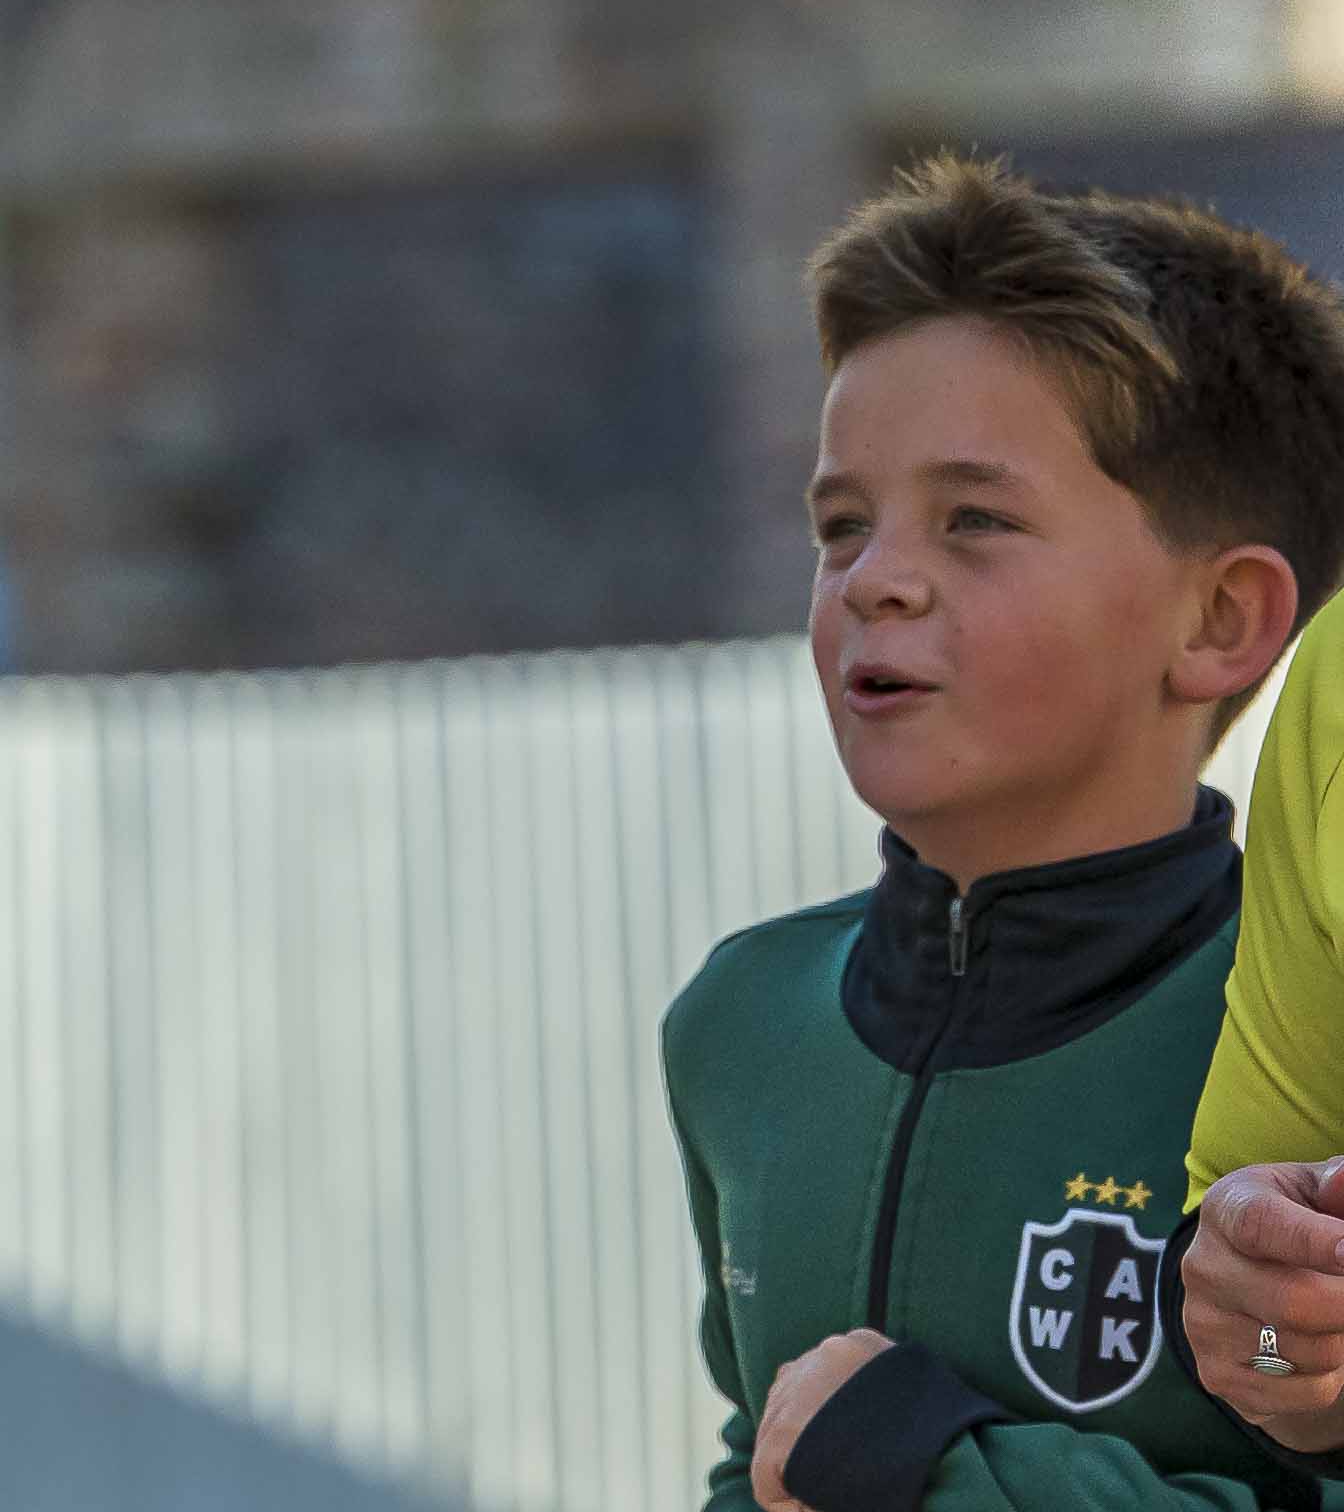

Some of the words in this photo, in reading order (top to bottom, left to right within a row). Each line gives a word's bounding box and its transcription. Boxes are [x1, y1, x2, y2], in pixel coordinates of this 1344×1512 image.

[1040, 1248, 1075, 1291] C
[1104, 1259, 1143, 1303] A
[1029, 1306, 1073, 1350] W
[1100, 1317, 1140, 1362] K
